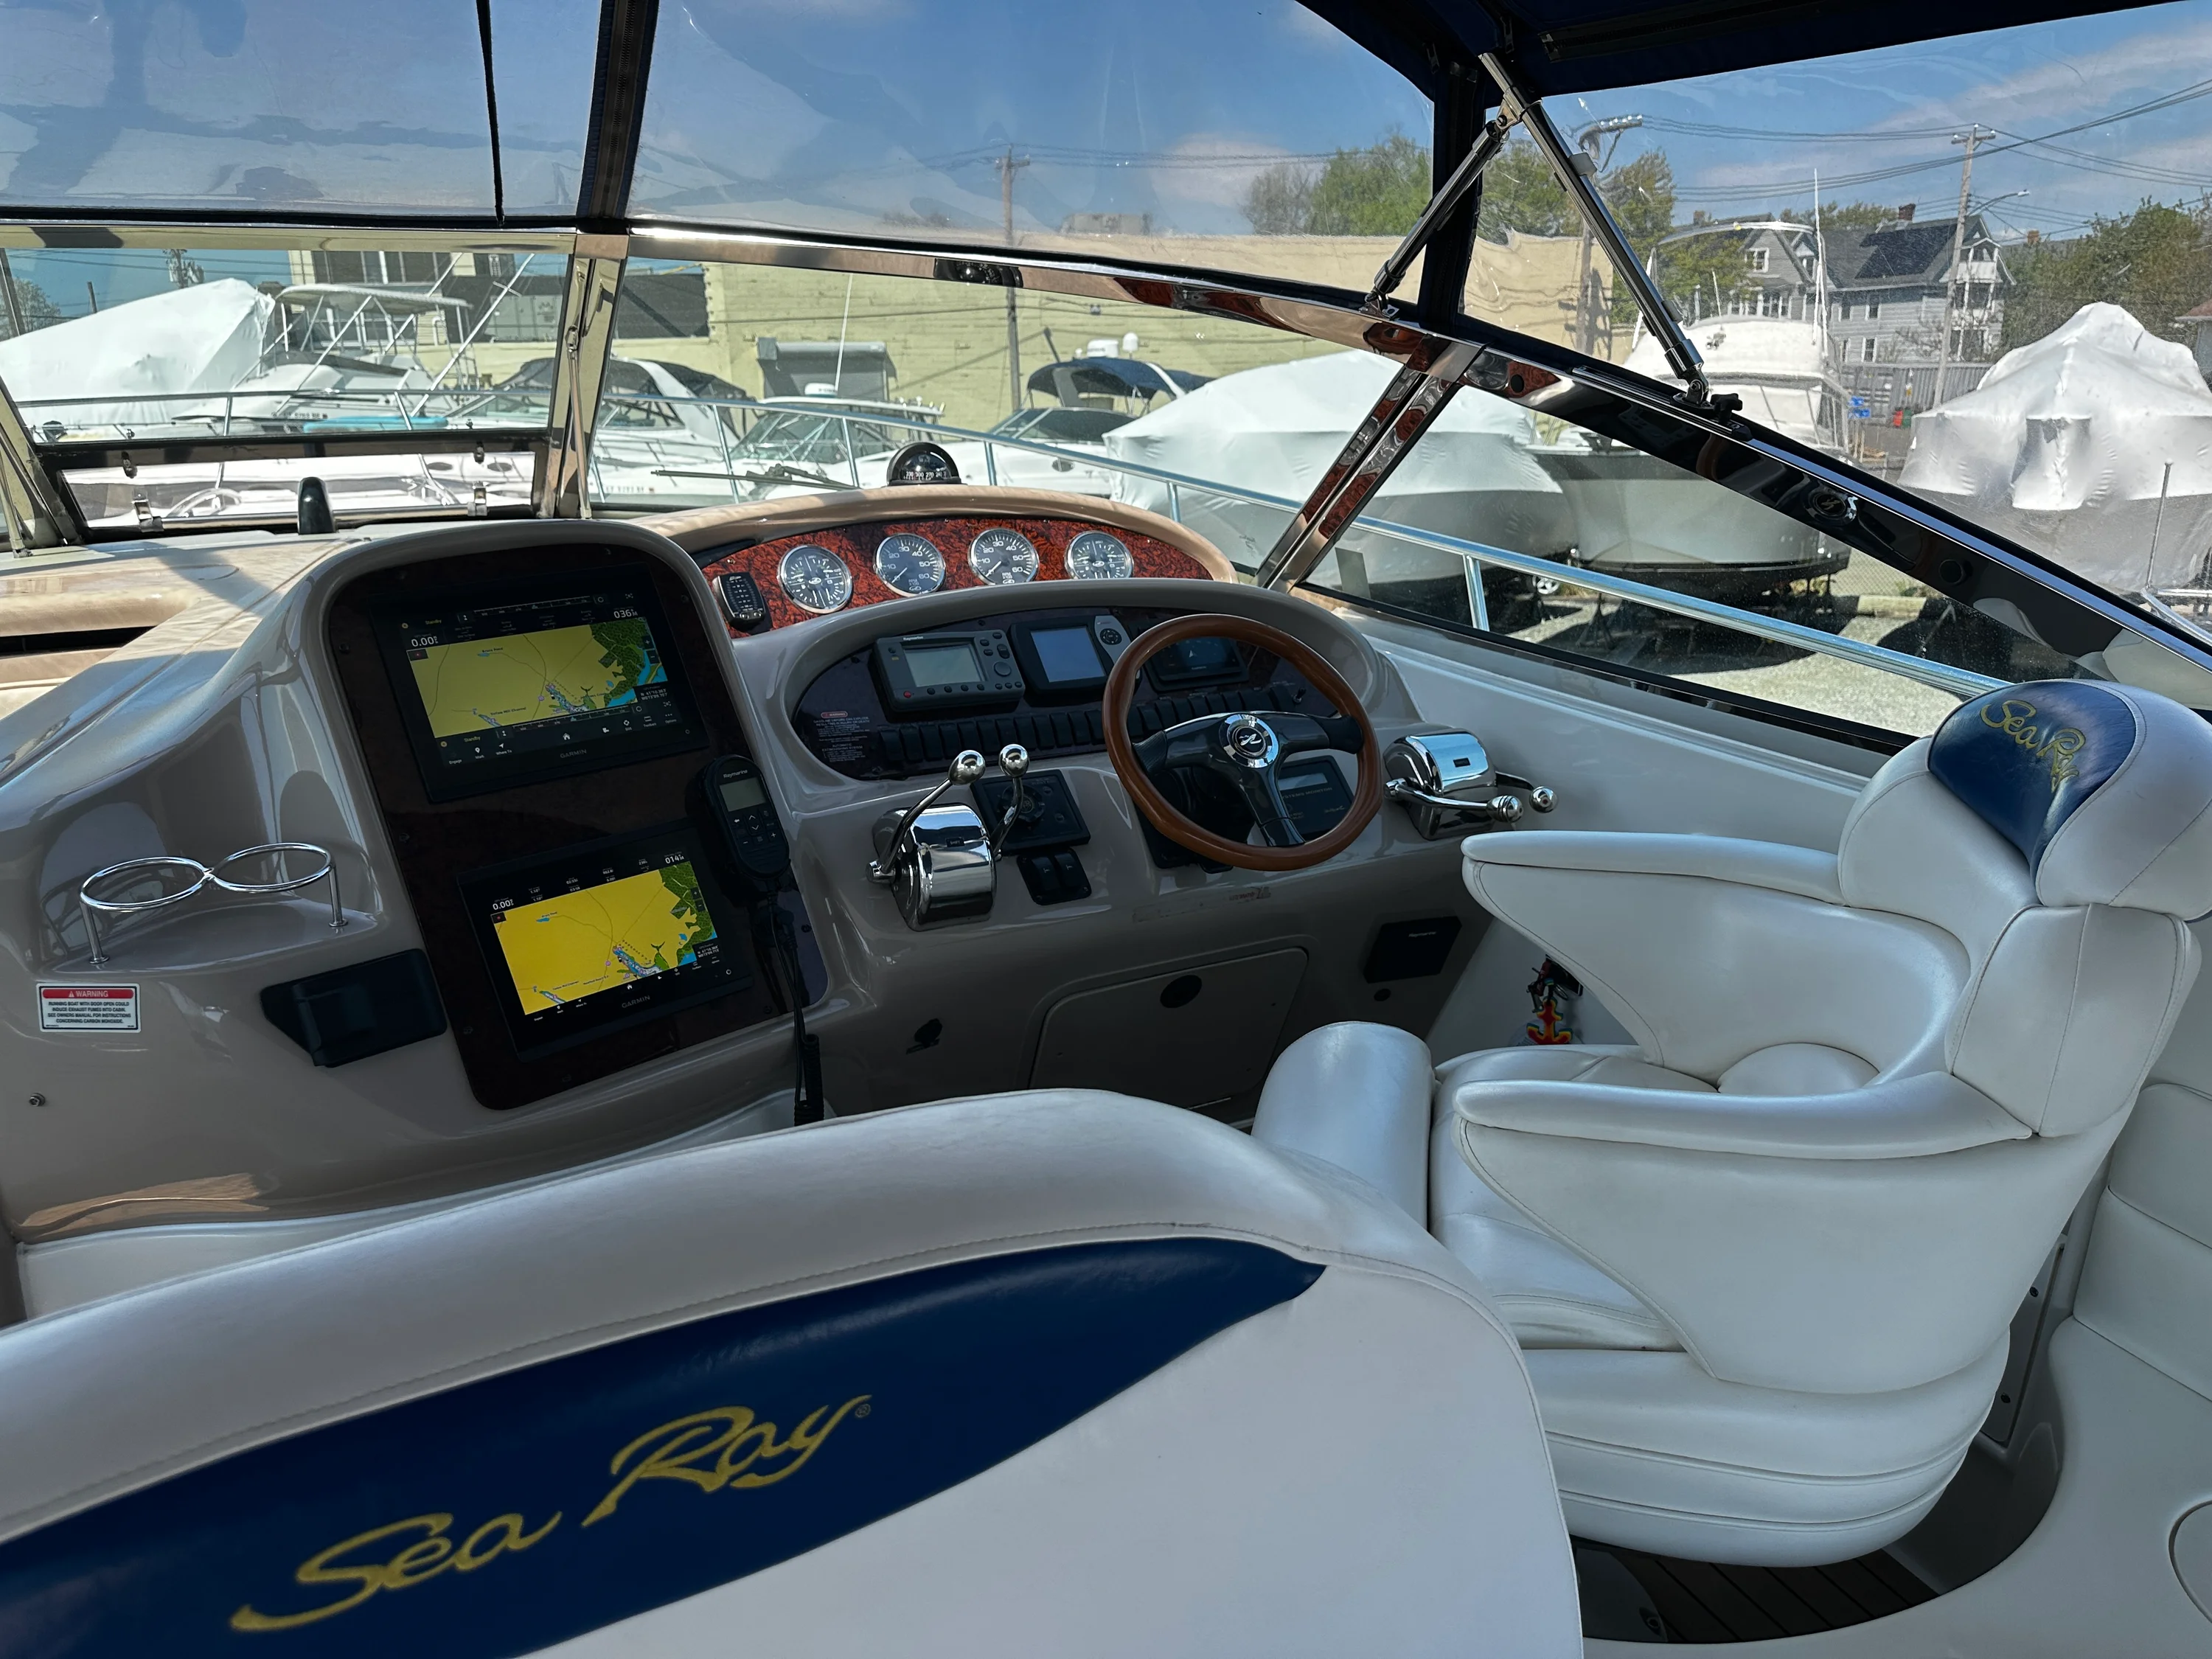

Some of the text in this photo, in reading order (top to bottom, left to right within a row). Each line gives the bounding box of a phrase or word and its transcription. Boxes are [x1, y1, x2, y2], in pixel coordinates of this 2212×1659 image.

[1980, 699, 2086, 793] Sea Ray
[560, 749, 587, 758] GARMIN
[723, 769, 748, 779] Raymarine
[1305, 787, 1332, 795] MONITOR
[621, 995, 651, 1009] GARMIN
[229, 1512, 562, 1632] Sea
